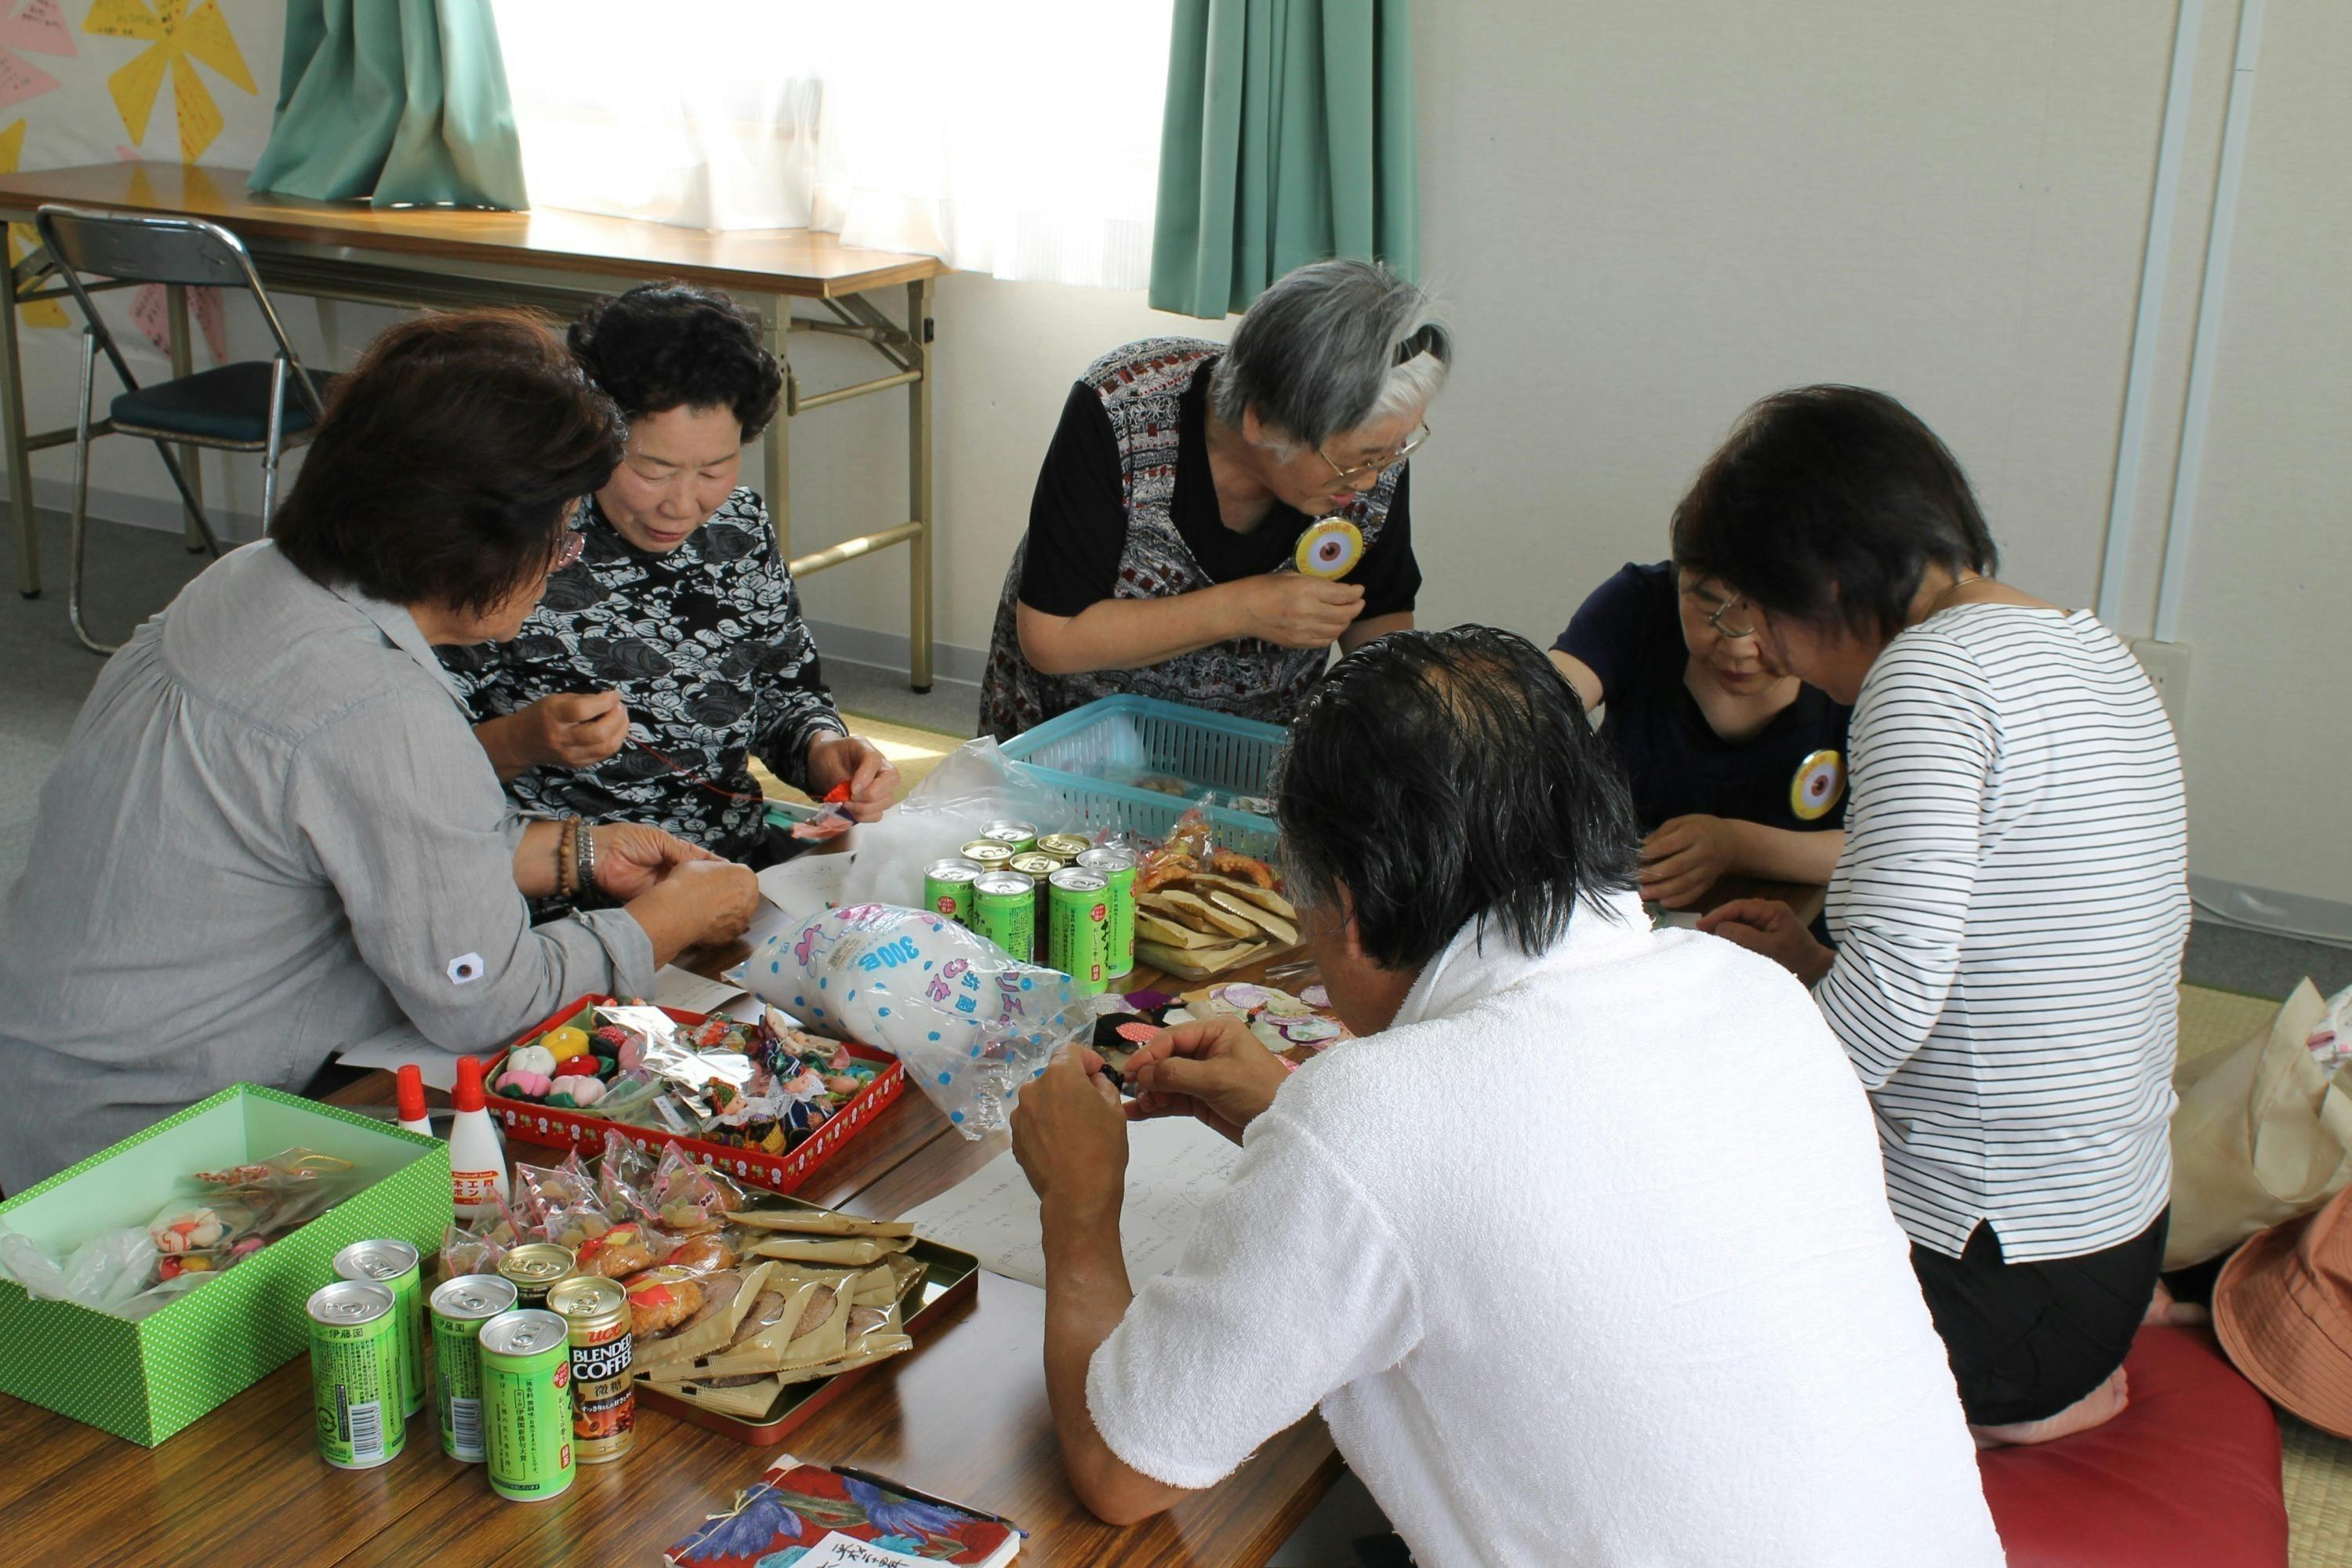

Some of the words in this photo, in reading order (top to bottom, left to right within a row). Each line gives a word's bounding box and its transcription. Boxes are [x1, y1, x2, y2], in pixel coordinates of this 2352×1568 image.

[328, 1327, 363, 1339] 伊藤園
[572, 1332, 632, 1363] BLENDED
[572, 1346, 633, 1380] COFFEE
[594, 1379, 622, 1397] 微糖
